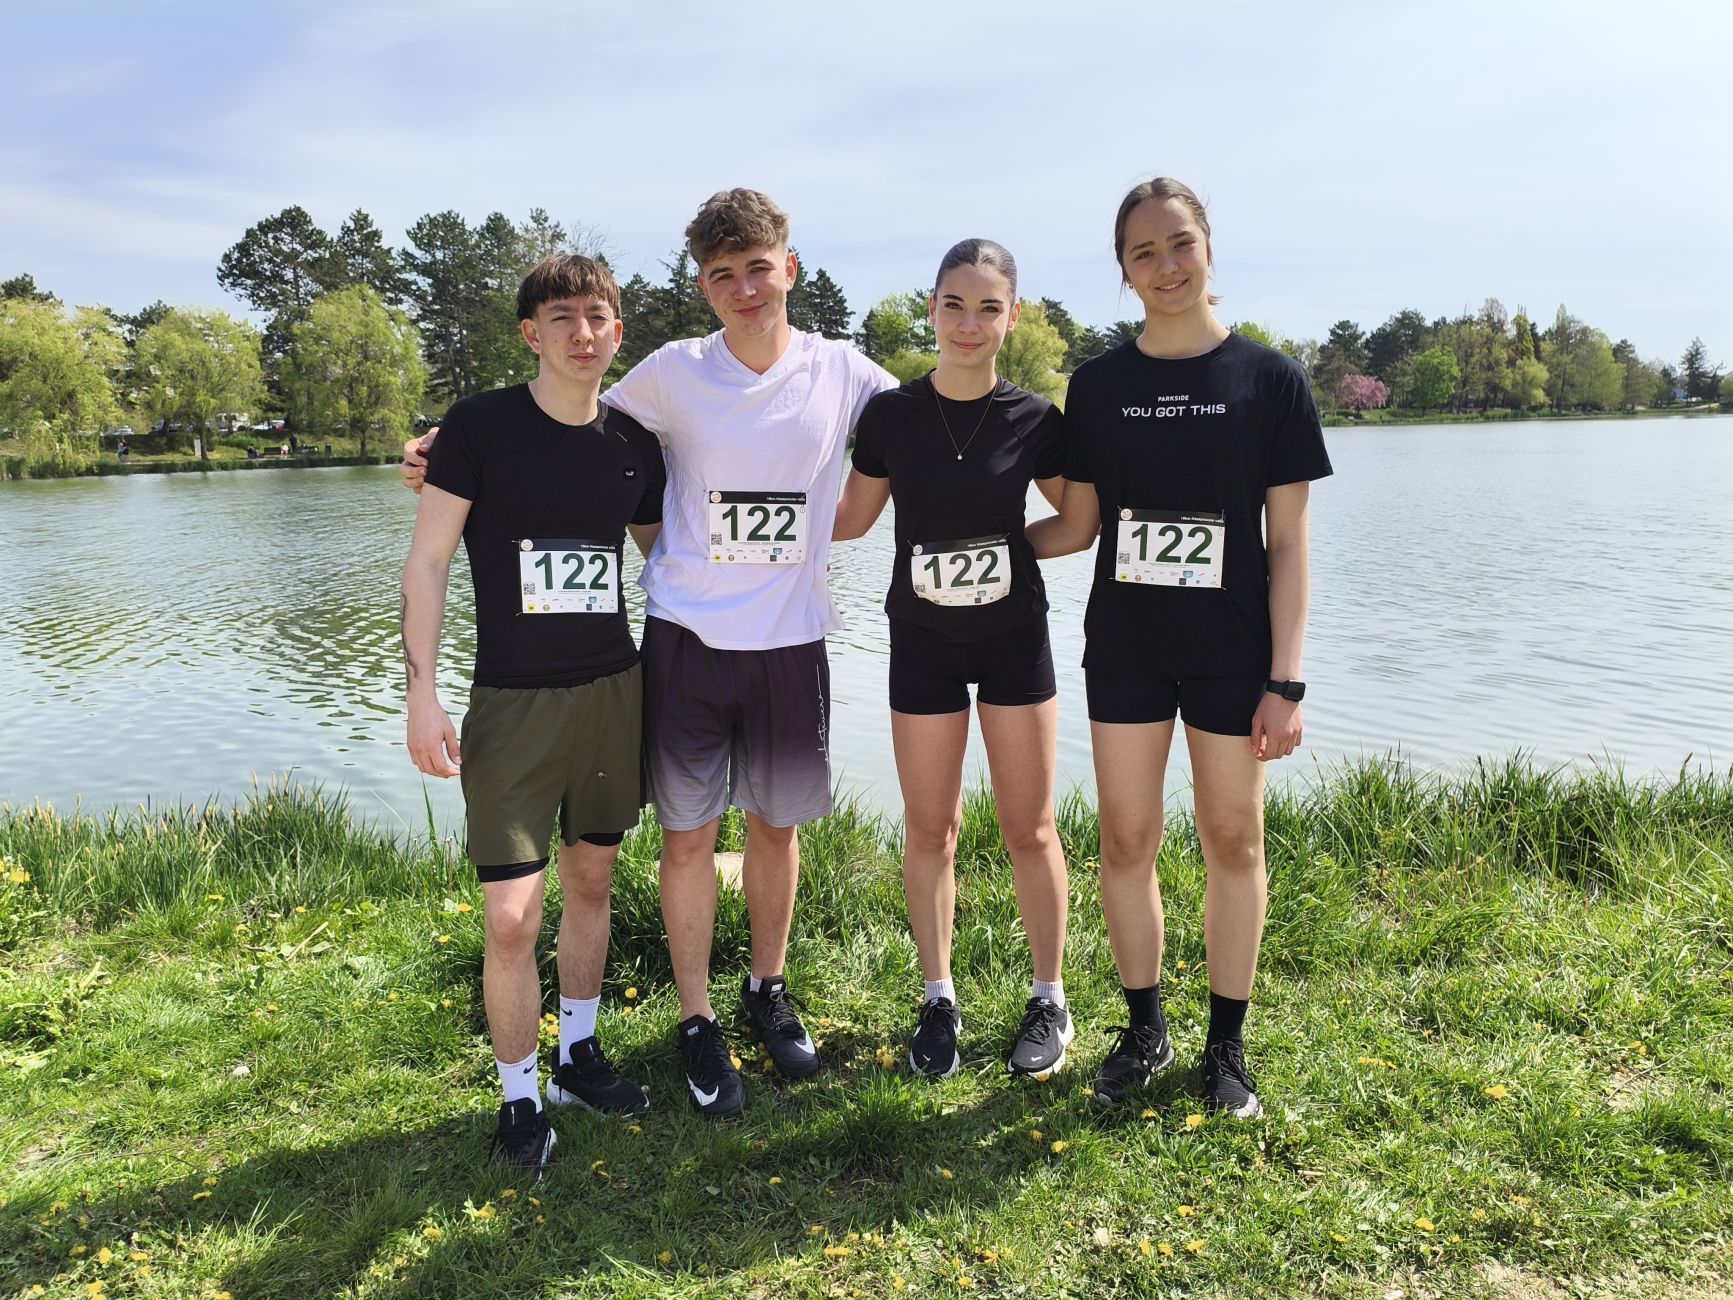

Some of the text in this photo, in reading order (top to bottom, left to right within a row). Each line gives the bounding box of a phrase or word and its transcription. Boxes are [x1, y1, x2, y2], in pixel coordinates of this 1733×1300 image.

[1121, 403, 1226, 418] YOU GOT THIS
[722, 505, 797, 542] 122
[1131, 523, 1213, 565] 122
[534, 552, 609, 591] 122
[923, 549, 1001, 590] 122
